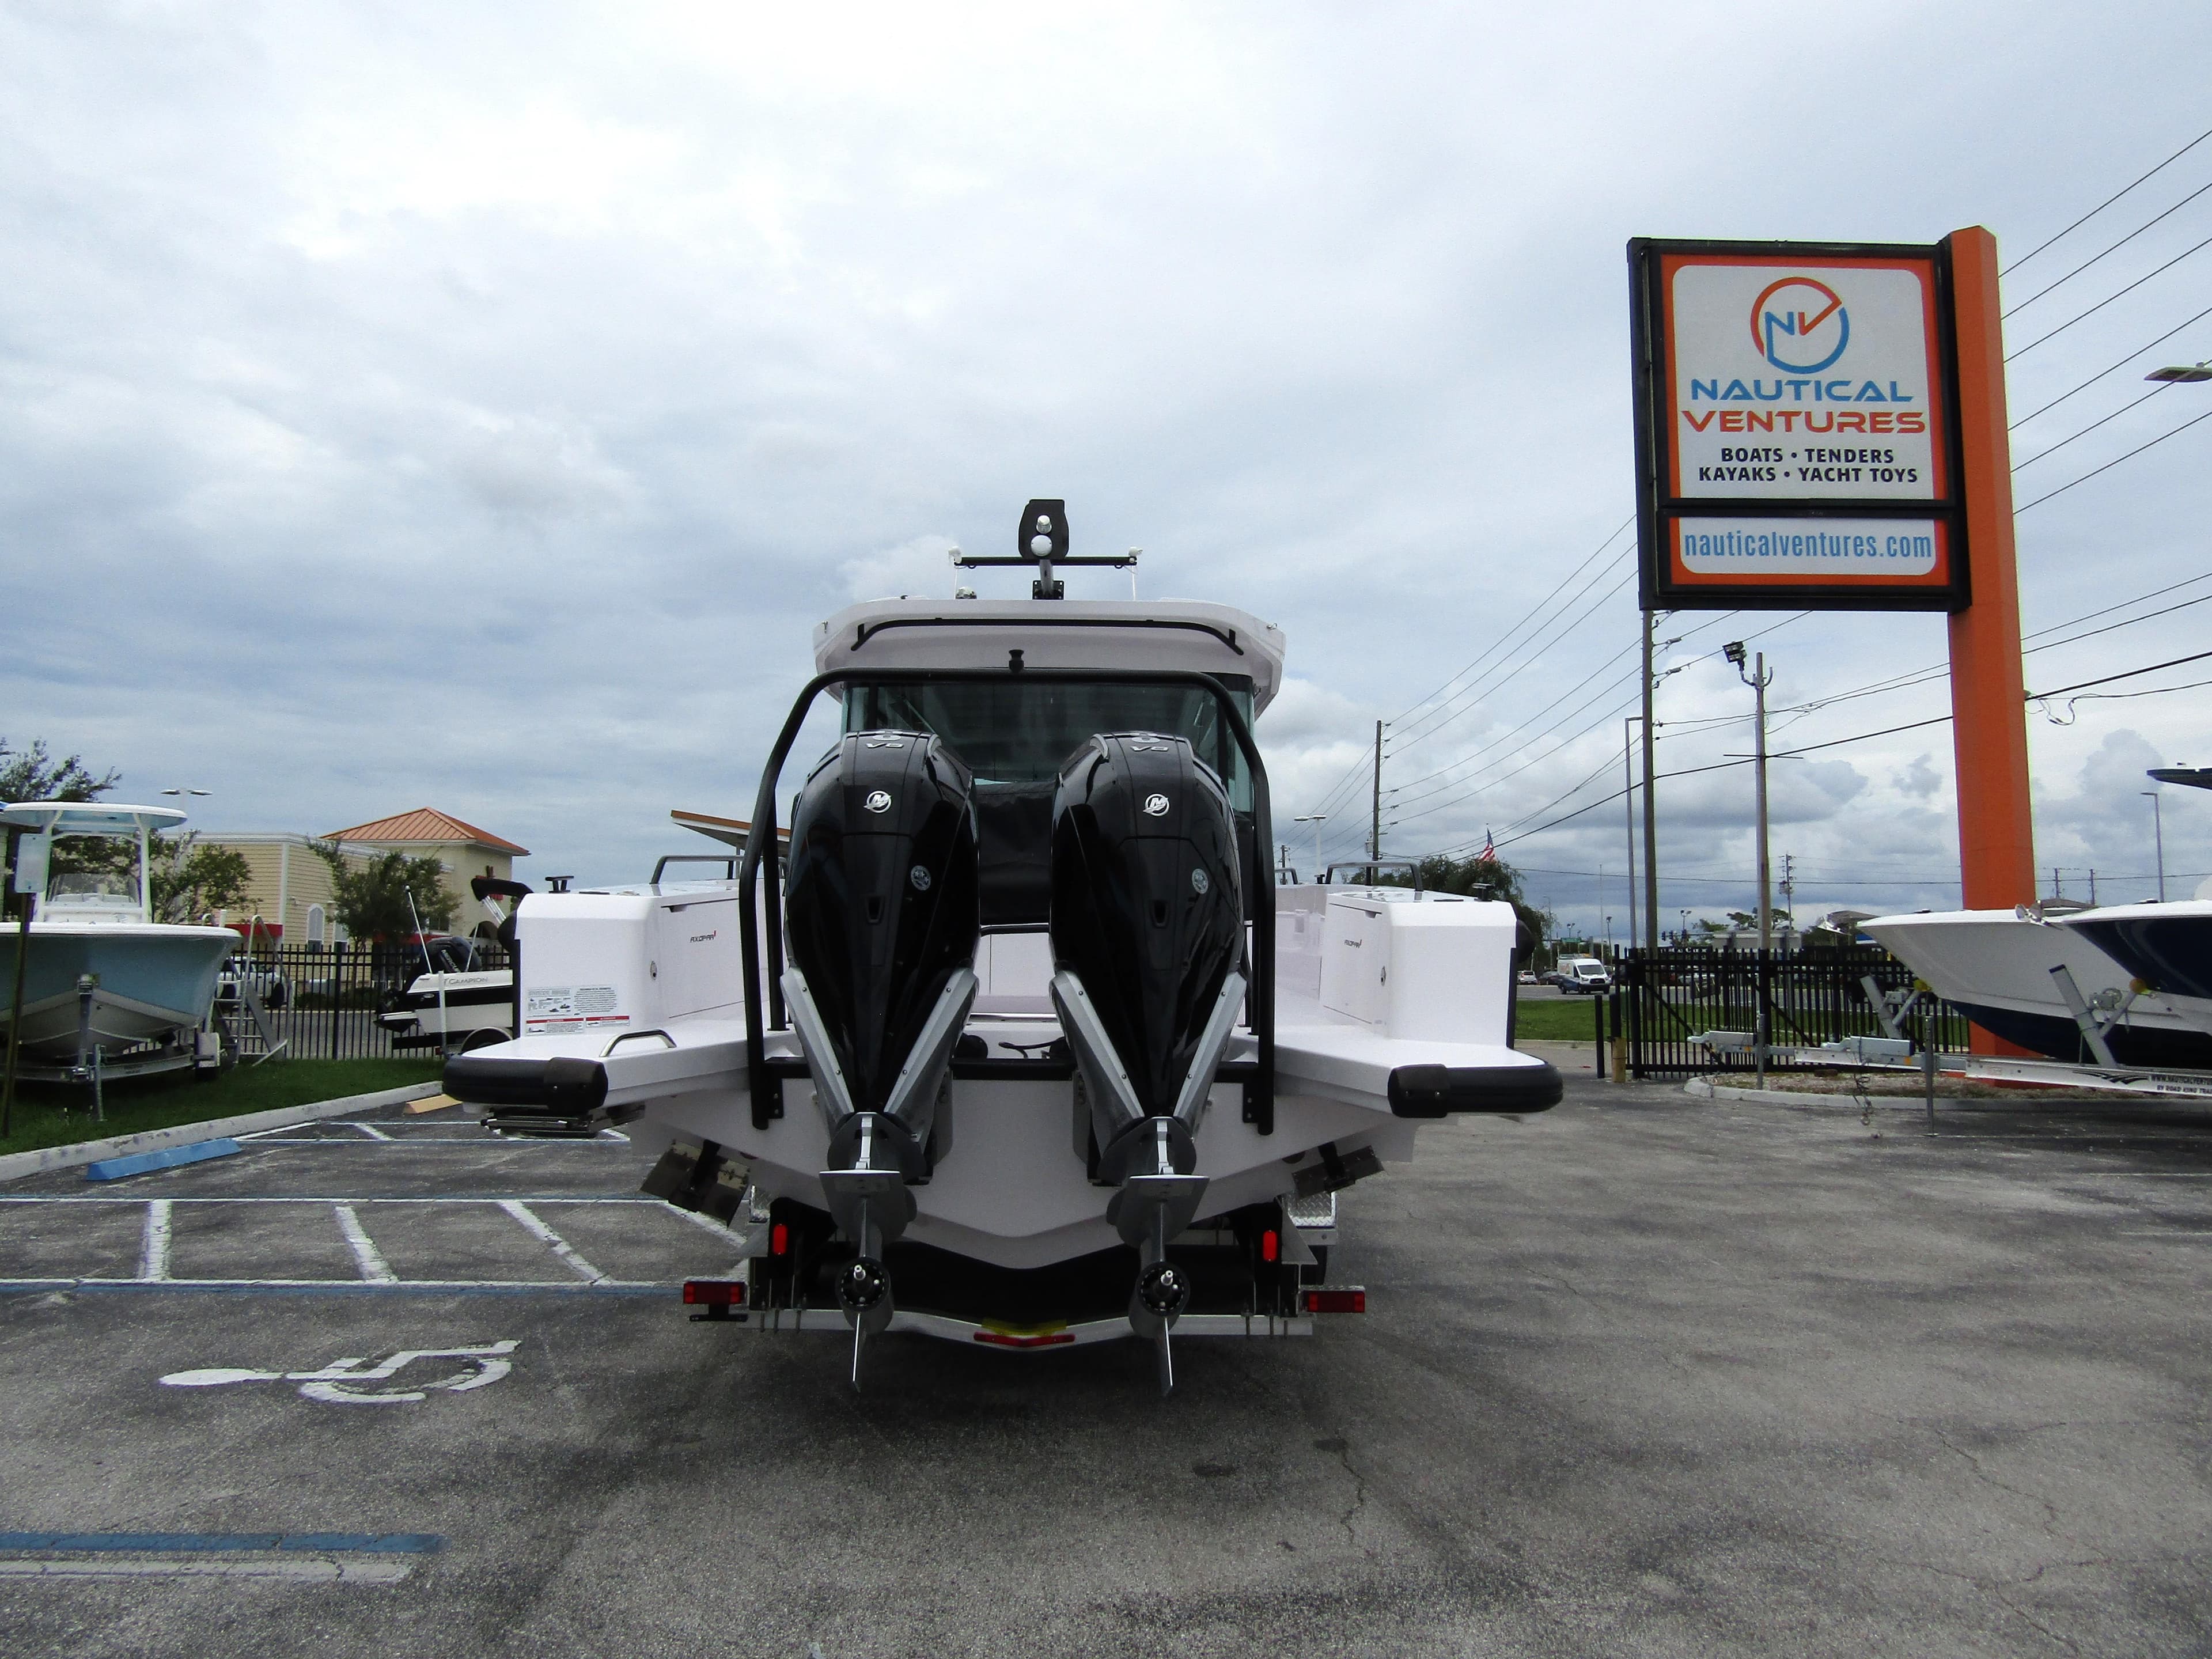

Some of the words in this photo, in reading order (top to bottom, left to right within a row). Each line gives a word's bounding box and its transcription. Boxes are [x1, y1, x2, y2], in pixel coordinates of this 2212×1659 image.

[1691, 378, 1912, 402] NAUTICAL
[1681, 411, 1926, 434] VENTURES
[1721, 448, 1783, 463] BOATS
[1805, 448, 1893, 464] TENDERS
[1699, 467, 1776, 482] KAYAKS
[1798, 467, 1861, 482] YACHT
[1869, 468, 1918, 483] TOYS
[1684, 531, 1932, 558] nauticalventures.com
